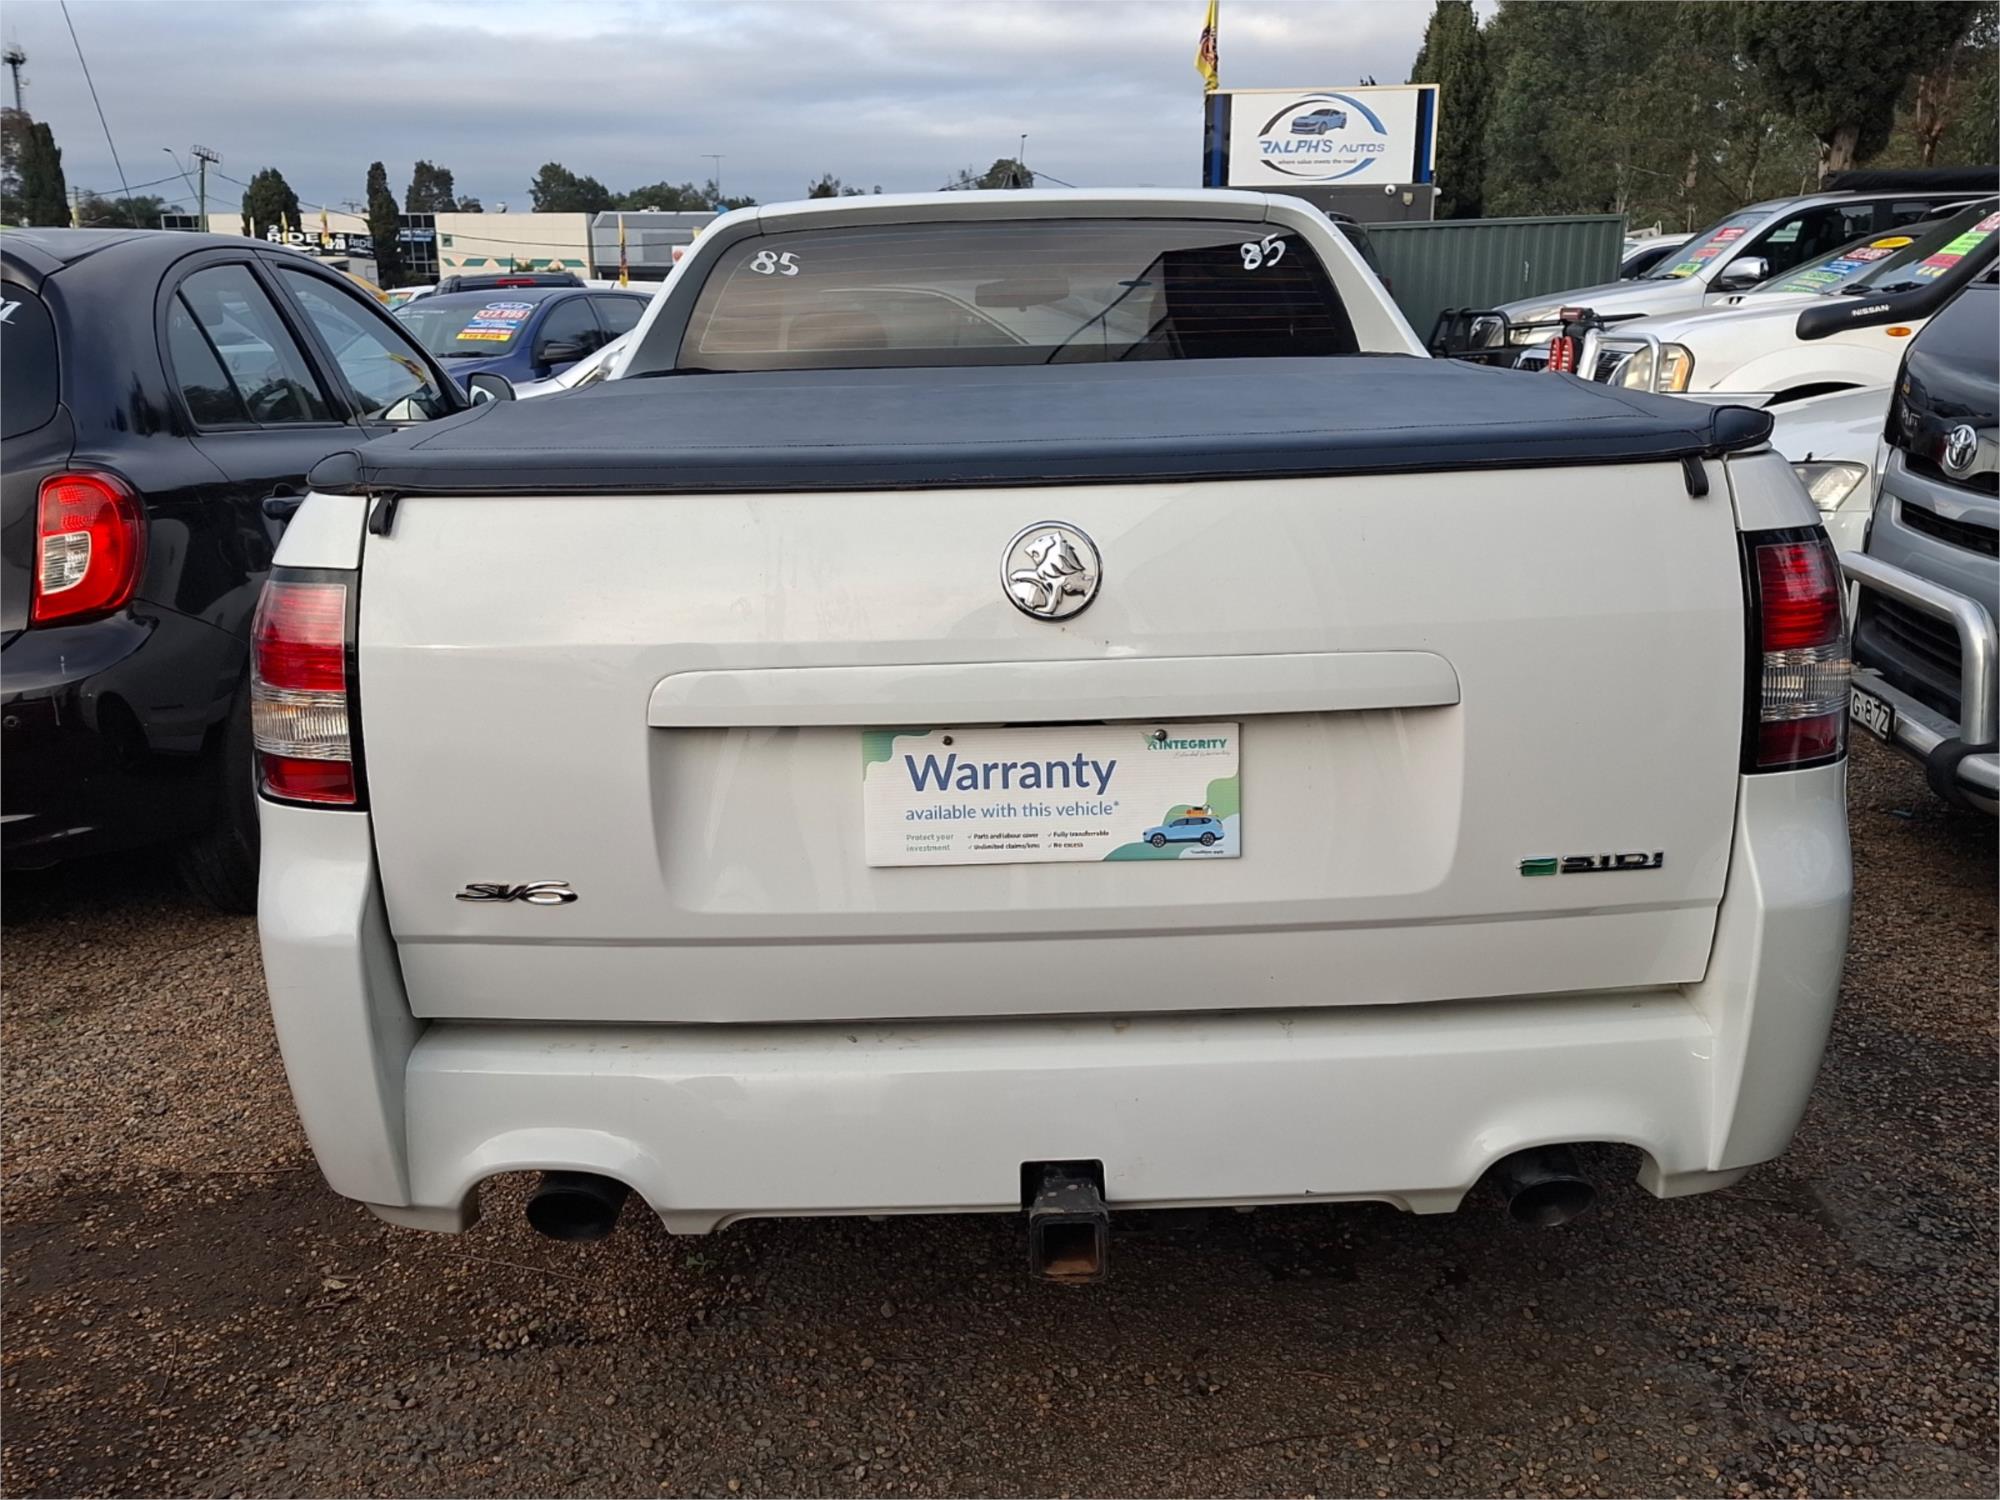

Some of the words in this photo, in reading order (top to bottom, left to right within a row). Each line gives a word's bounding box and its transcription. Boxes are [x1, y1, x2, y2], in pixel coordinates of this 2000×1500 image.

[1259, 139, 1333, 154] RALPH'S
[1337, 143, 1385, 153] AUTOS
[266, 231, 320, 244] RDE
[1240, 232, 1286, 270] 85
[750, 250, 800, 276] 85
[1852, 304, 1890, 316] NISSAN
[1159, 738, 1228, 750] INTEGRITY
[905, 753, 1117, 795] Warranty
[905, 804, 977, 820] available
[981, 803, 1017, 818] with
[1022, 802, 1052, 817] this
[906, 833, 935, 841] Protect
[936, 834, 954, 842] your
[906, 844, 951, 852] investment
[455, 880, 578, 905] SV6
